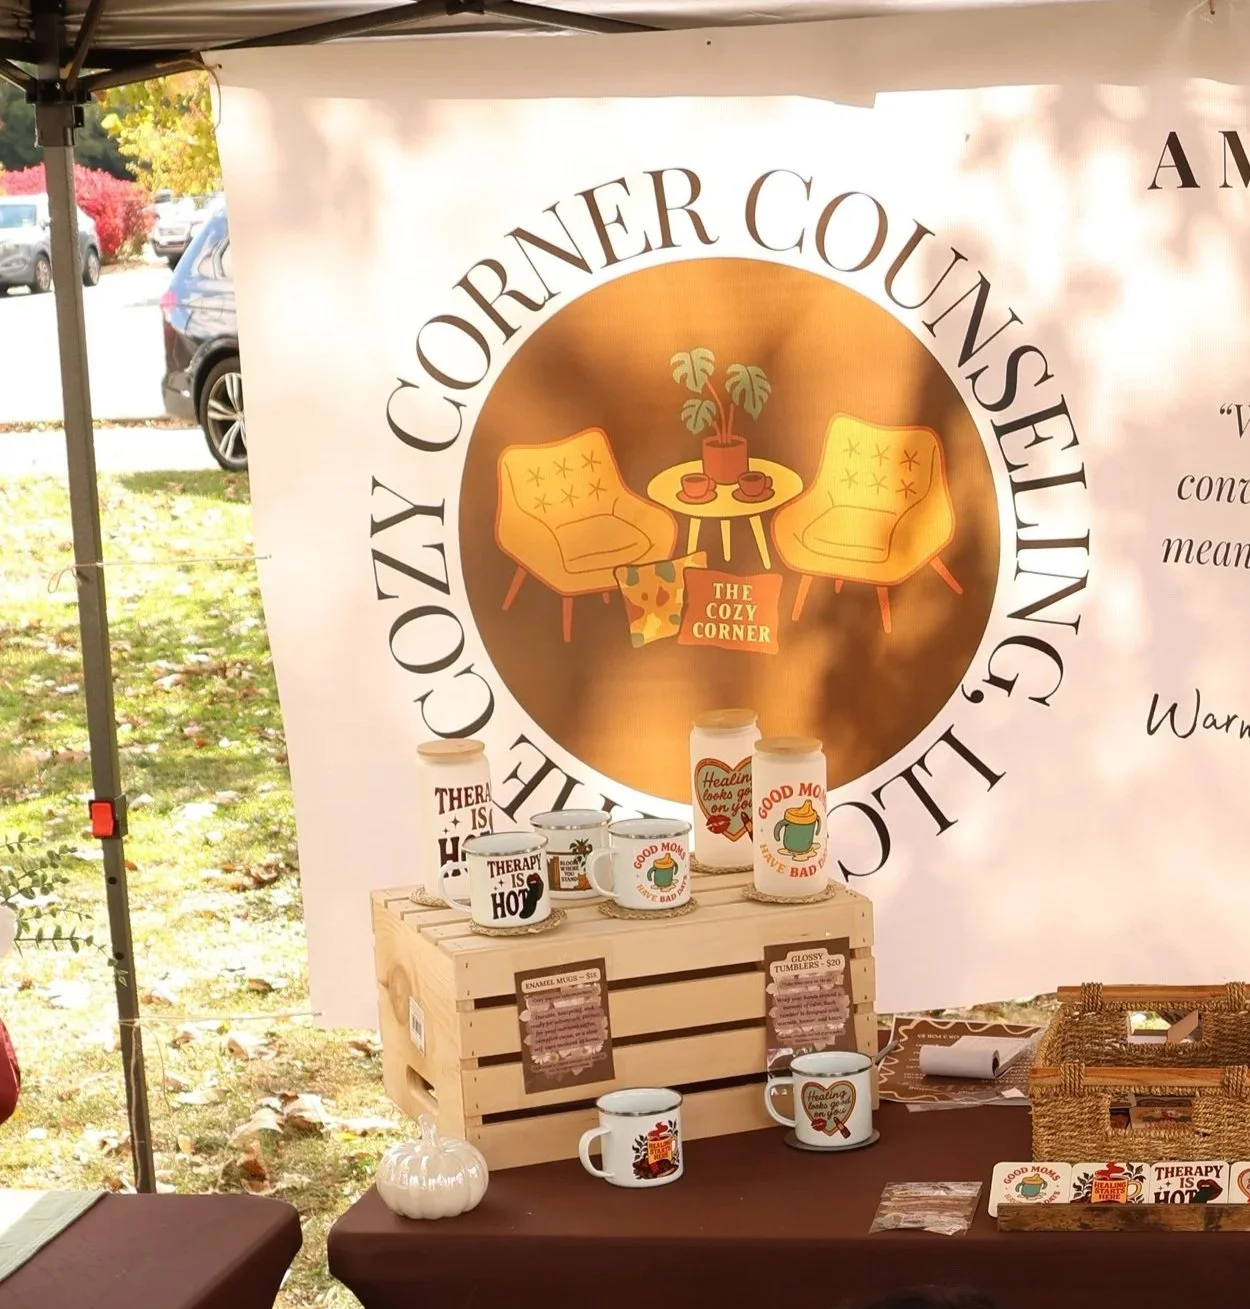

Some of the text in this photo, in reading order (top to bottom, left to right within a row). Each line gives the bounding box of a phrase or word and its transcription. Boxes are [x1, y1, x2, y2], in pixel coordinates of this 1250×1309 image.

[1147, 131, 1201, 190] A
[386, 166, 720, 453] CORNER
[744, 168, 1091, 708] COUNSELING,
[713, 583, 753, 601] THE
[371, 474, 495, 740] COZY
[706, 602, 758, 622] COZY
[693, 621, 771, 643] CORNER
[703, 788, 732, 801] looks
[758, 785, 794, 819] GOOD
[827, 724, 1007, 883] LLC
[471, 806, 488, 831] IS
[711, 804, 729, 813] on
[487, 853, 542, 878] THERAPY
[633, 841, 687, 870] GOOD MOMS
[760, 843, 786, 874] HAVE
[790, 865, 817, 877] BAD
[511, 872, 525, 888] IS
[636, 884, 657, 902] HAVE
[659, 893, 677, 903] BAD
[490, 889, 528, 919] HOT
[774, 961, 819, 973] TUMBLERS
[826, 959, 841, 967] $20
[791, 952, 824, 963] GLOSSY
[525, 979, 555, 990] ENAMEL
[556, 975, 577, 985] MUGS
[807, 1090, 847, 1101] Healing
[807, 1094, 851, 1111] looks good
[1004, 1165, 1061, 1185] GOOD MOMS
[1154, 1165, 1223, 1181] THERAPY
[1179, 1177, 1195, 1189] IS
[1094, 1181, 1126, 1189] HEALING
